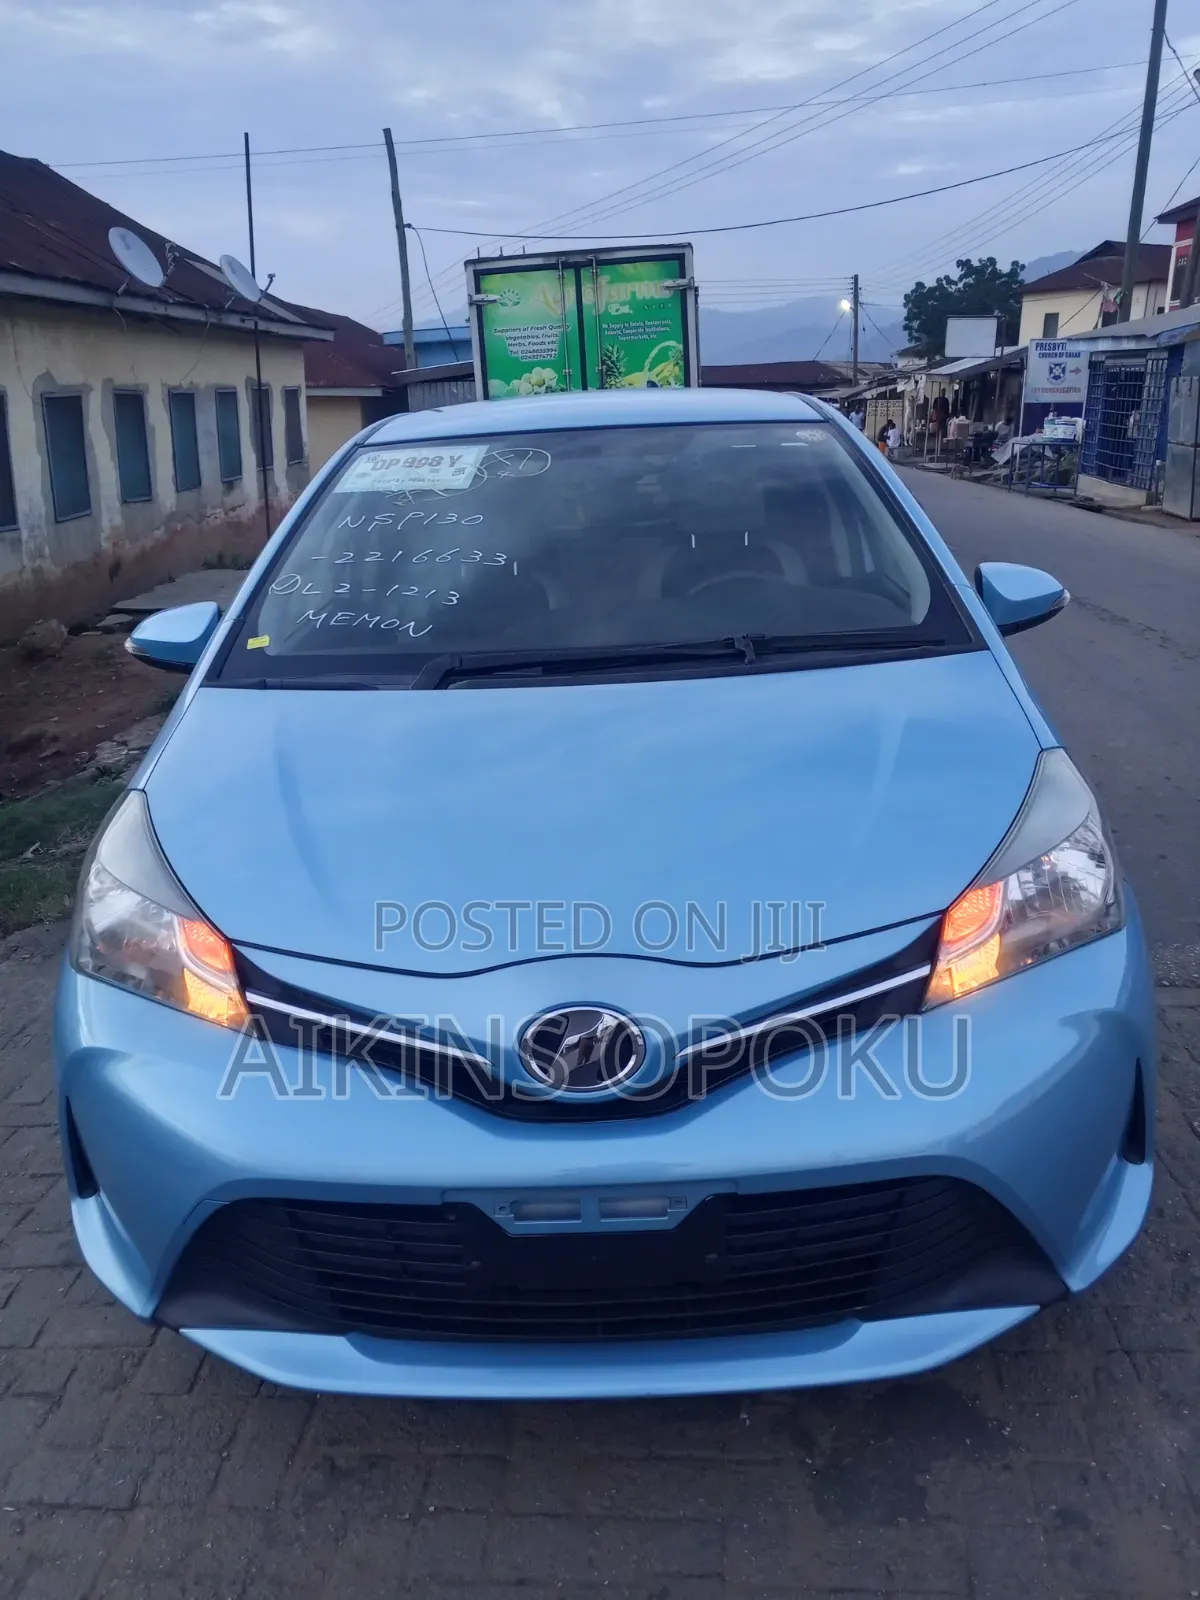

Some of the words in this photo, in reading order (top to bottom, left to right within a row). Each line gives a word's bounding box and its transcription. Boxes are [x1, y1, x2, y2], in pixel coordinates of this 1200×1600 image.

[493, 326, 521, 334] Suppliers
[371, 458, 401, 471] DP
[296, 610, 433, 637] MEMON
